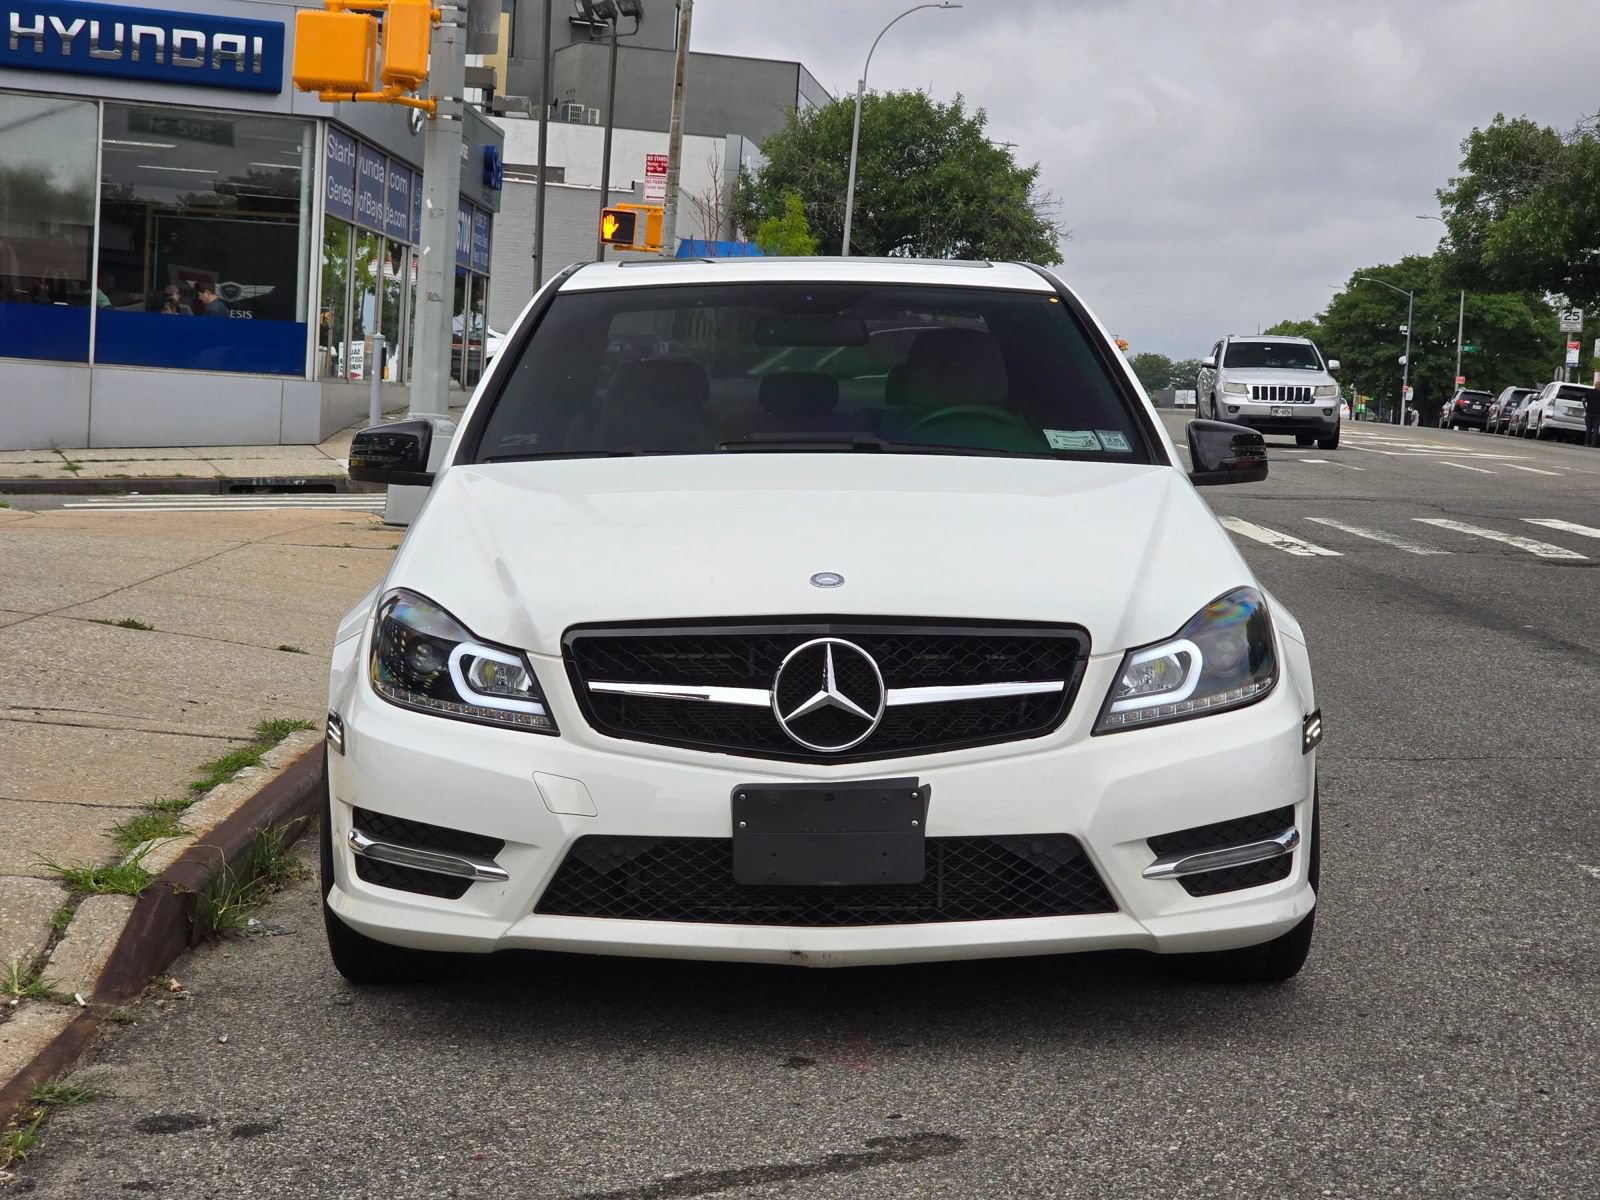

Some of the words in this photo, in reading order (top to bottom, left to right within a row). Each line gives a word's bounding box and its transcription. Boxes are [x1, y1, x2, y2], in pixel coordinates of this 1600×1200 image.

[9, 12, 263, 74] HYUNDAI
[230, 309, 253, 319] ESIS
[1563, 311, 1580, 321] 25
